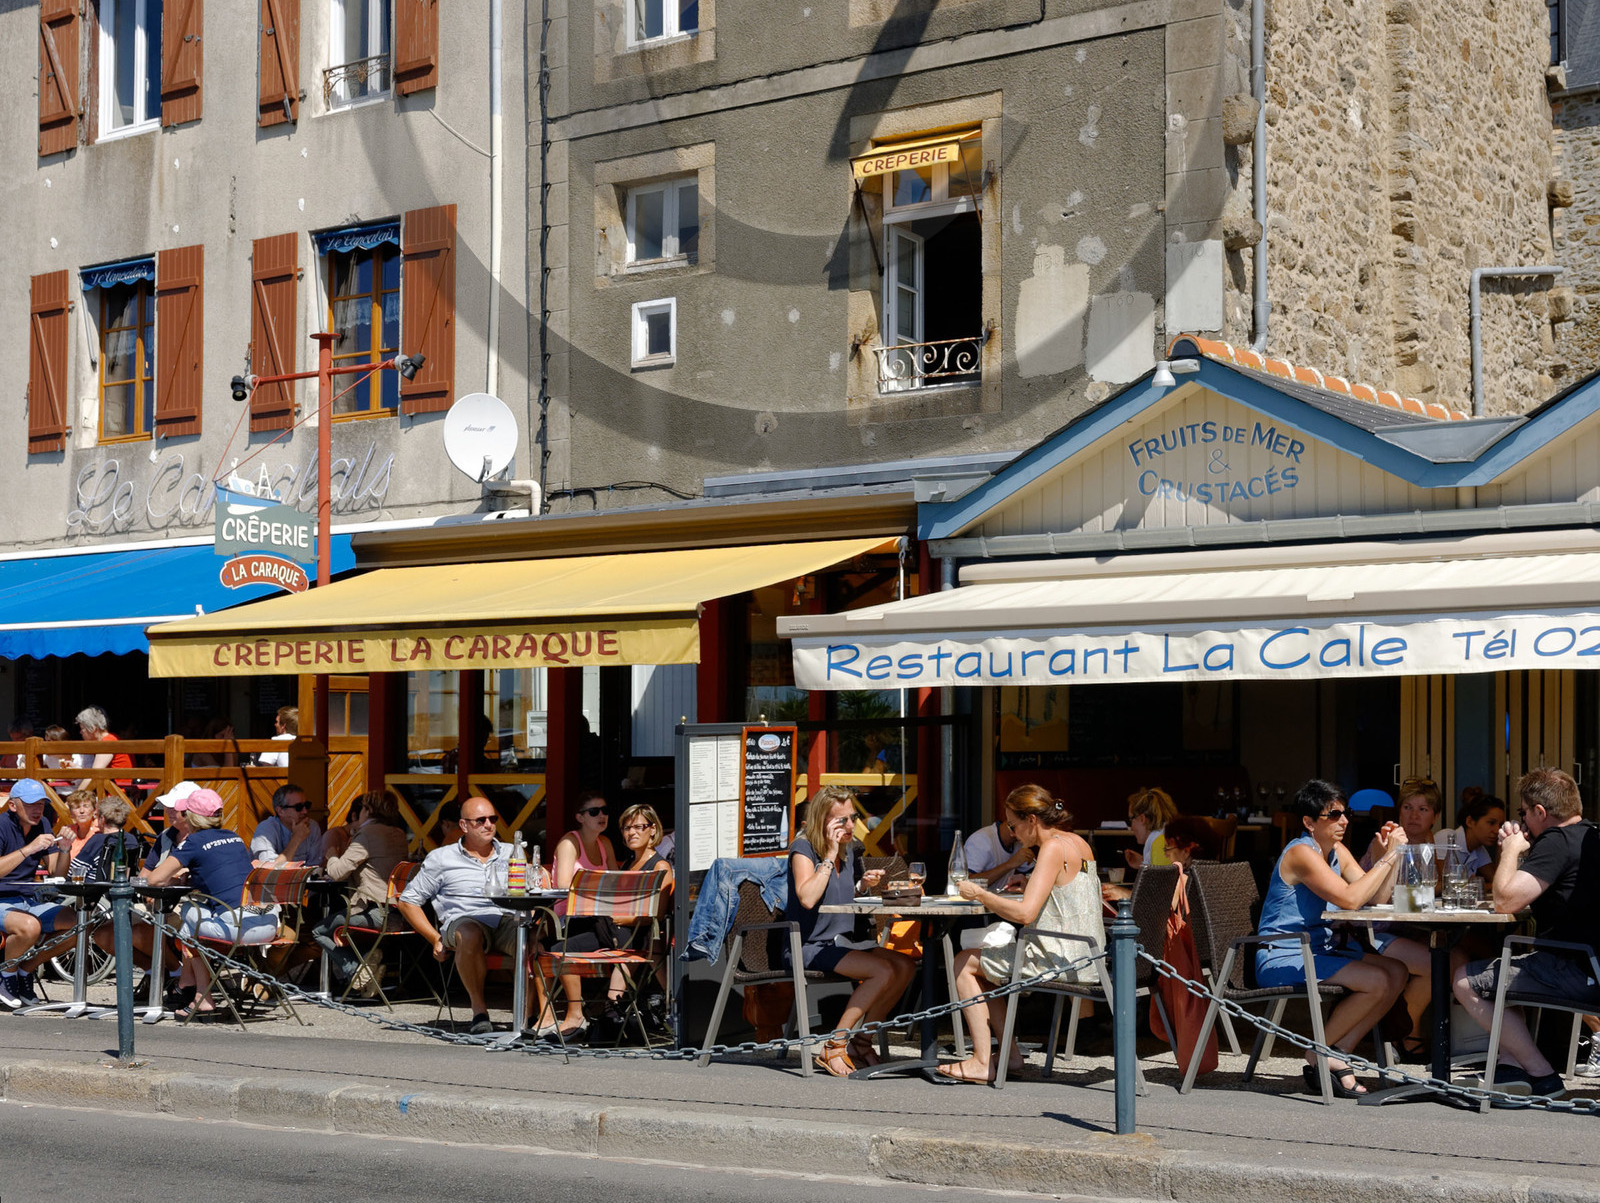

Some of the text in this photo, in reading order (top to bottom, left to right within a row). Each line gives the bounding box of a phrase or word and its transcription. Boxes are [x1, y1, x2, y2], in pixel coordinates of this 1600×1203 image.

[1128, 420, 1305, 467] FRUITS DE MER
[1208, 448, 1232, 475] &
[66, 458, 134, 526] Le
[1138, 465, 1300, 505] CRUSTACÉS
[222, 514, 309, 548] CRÊPERIE
[231, 561, 300, 587] LA CARAQUE
[213, 630, 619, 666] CRÊPERIE LA CARAQUE
[826, 625, 1600, 681] Restaurant La Cale Tél 02
